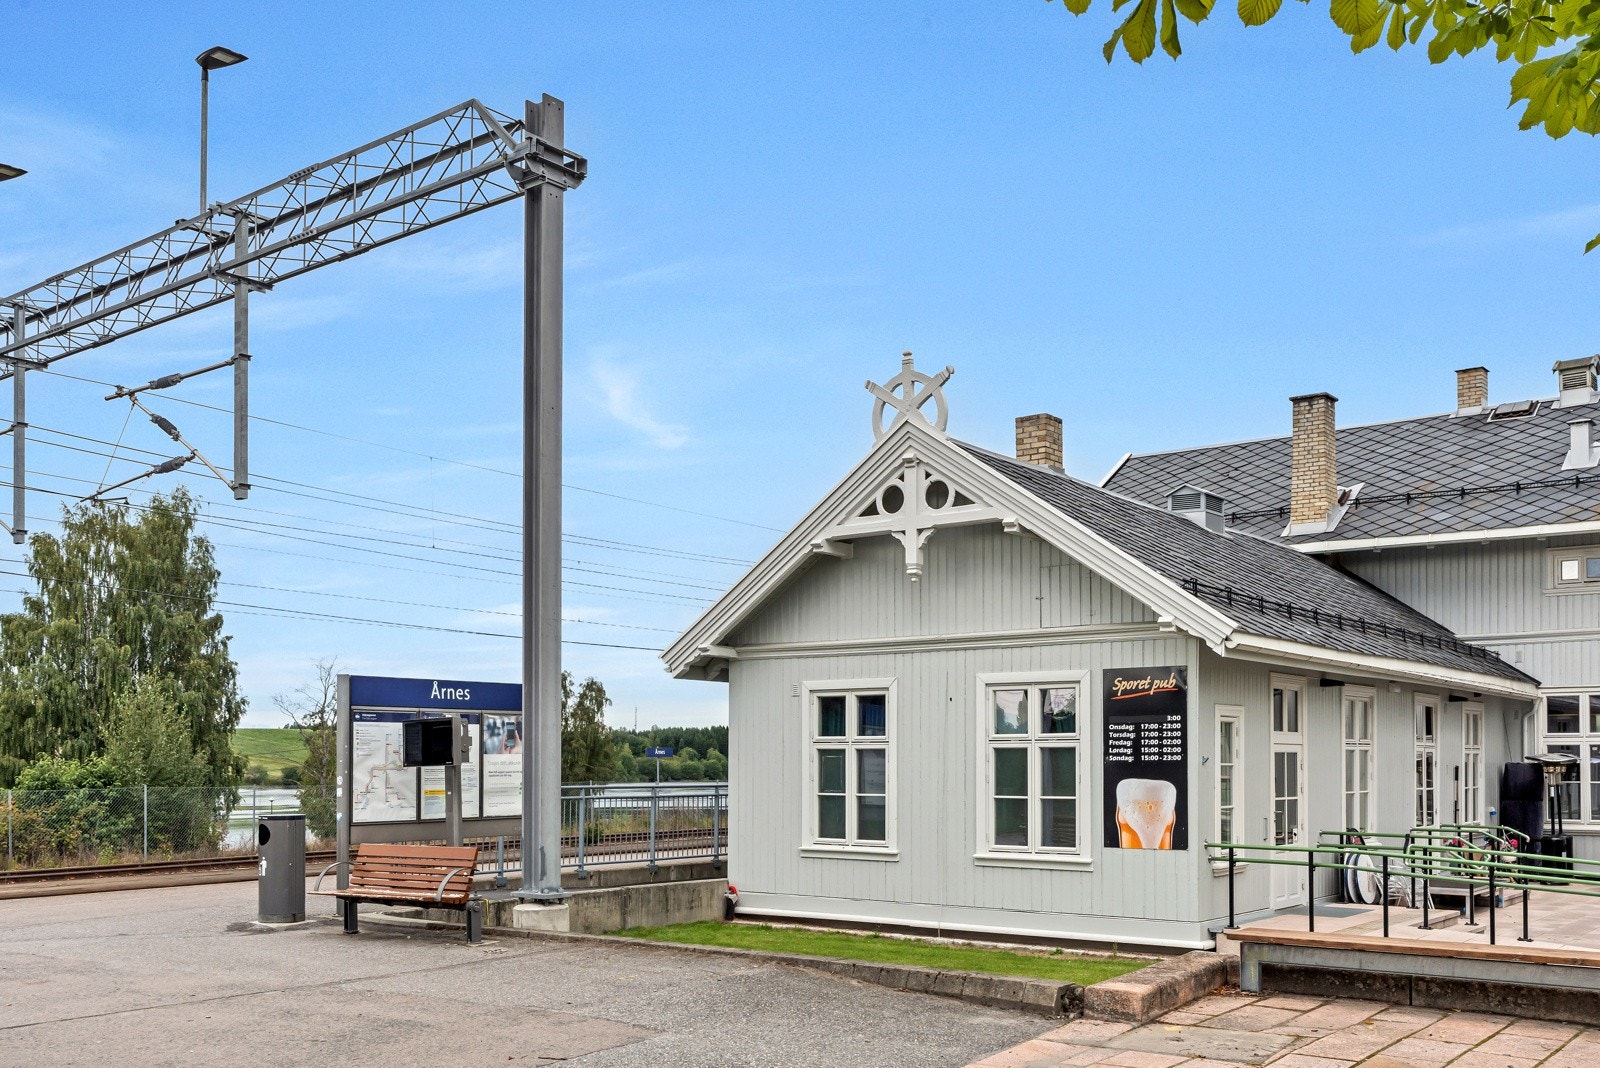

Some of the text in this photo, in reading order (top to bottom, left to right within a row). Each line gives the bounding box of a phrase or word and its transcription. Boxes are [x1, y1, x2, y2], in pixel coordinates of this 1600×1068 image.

[431, 681, 470, 700] Årnes
[1112, 672, 1176, 696] Sporet pub
